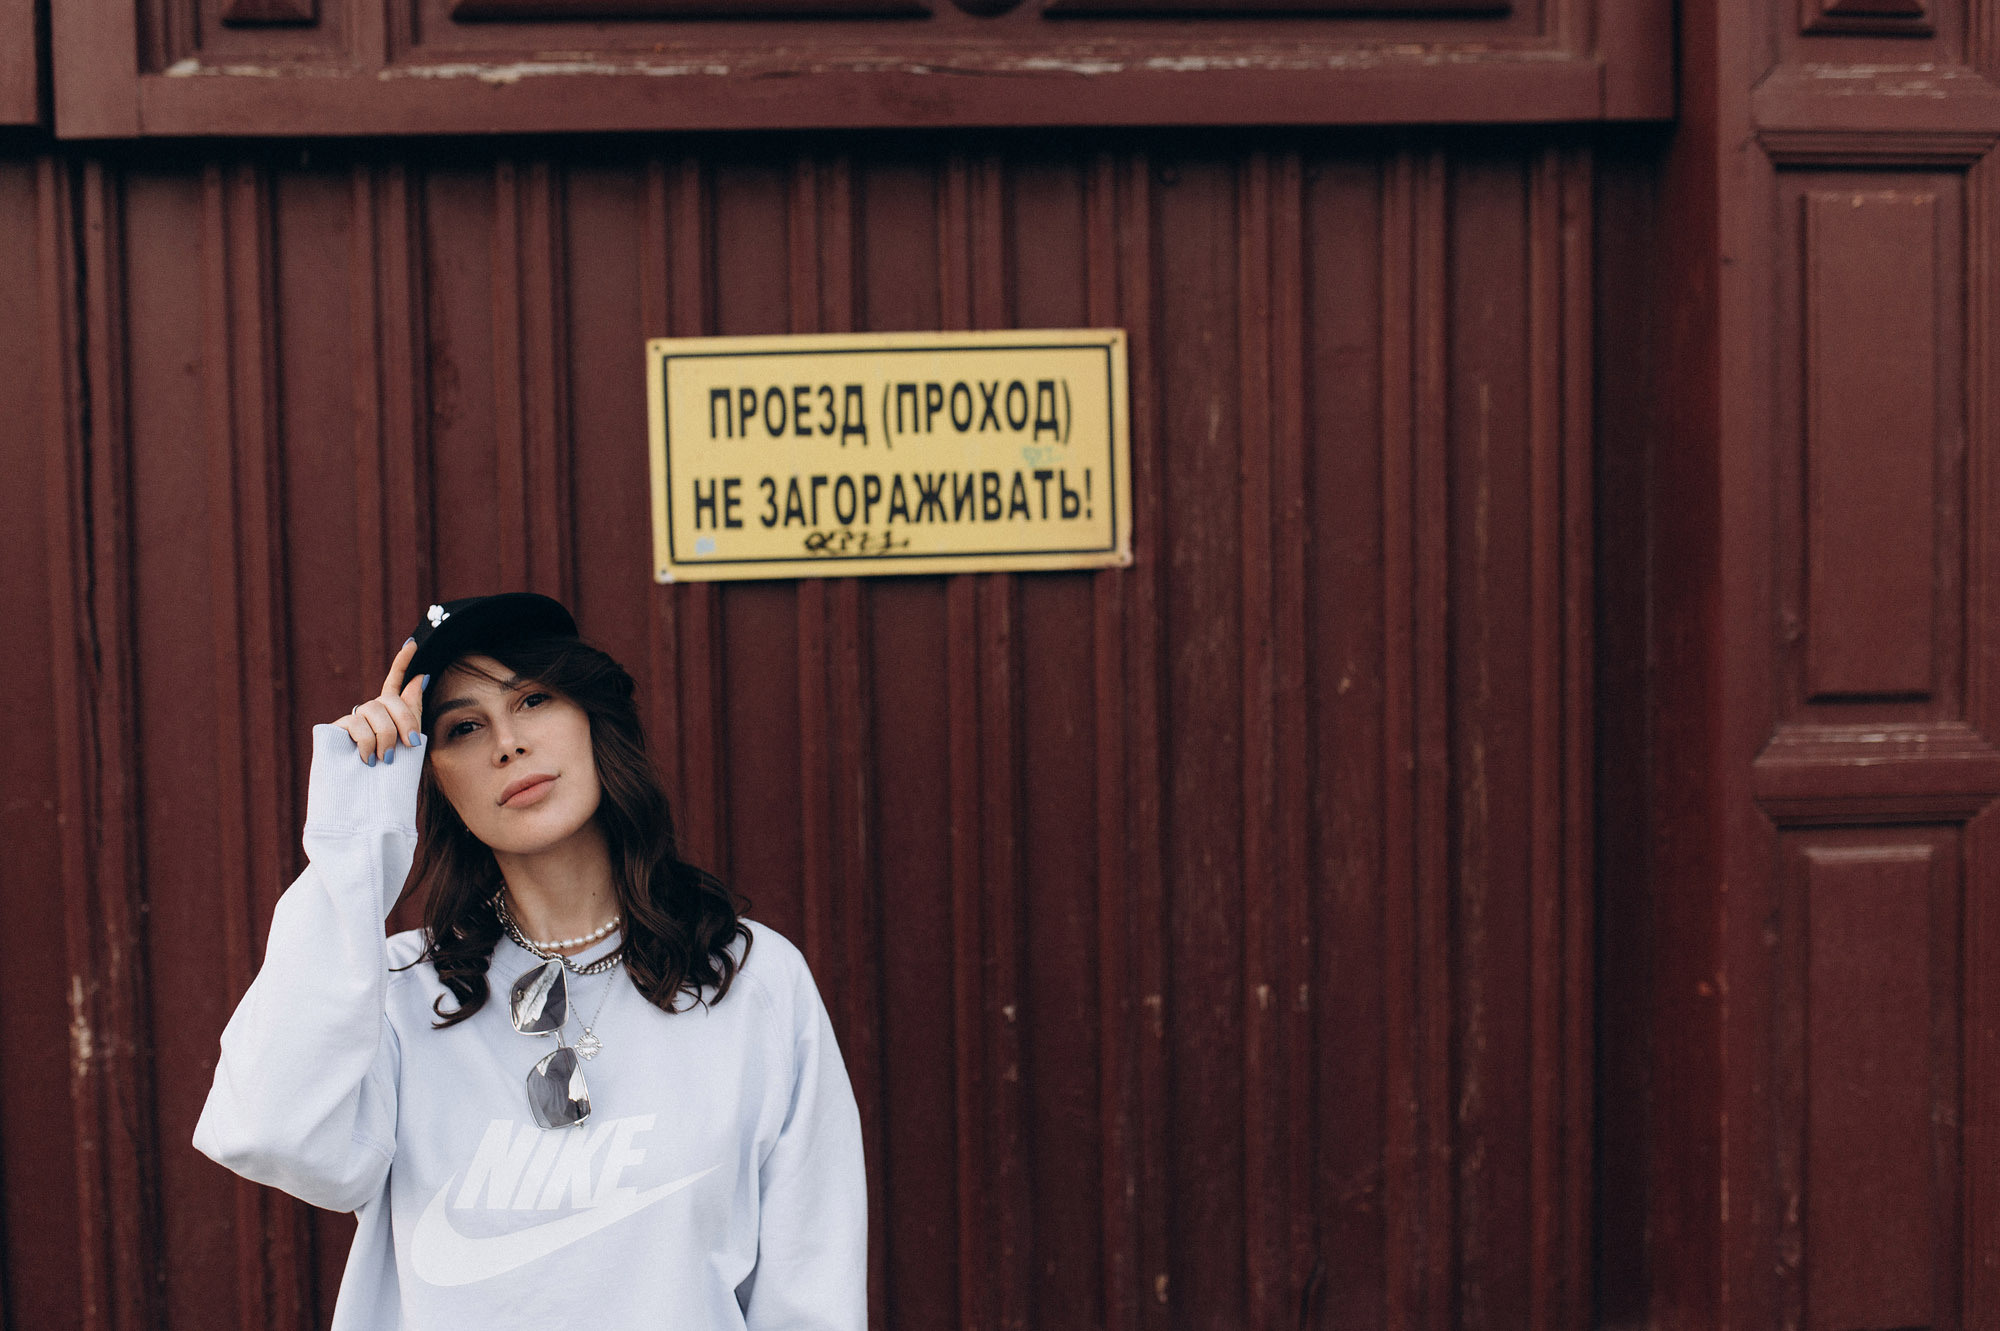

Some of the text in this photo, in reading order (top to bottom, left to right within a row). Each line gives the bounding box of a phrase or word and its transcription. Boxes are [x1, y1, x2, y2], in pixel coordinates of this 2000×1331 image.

[709, 378, 1072, 450] ПРОЕЗД (ПРОХОД)
[693, 467, 1093, 530] НЕ ЗАГОРАЖИВАТЬ!
[452, 1113, 657, 1211] NIKE
